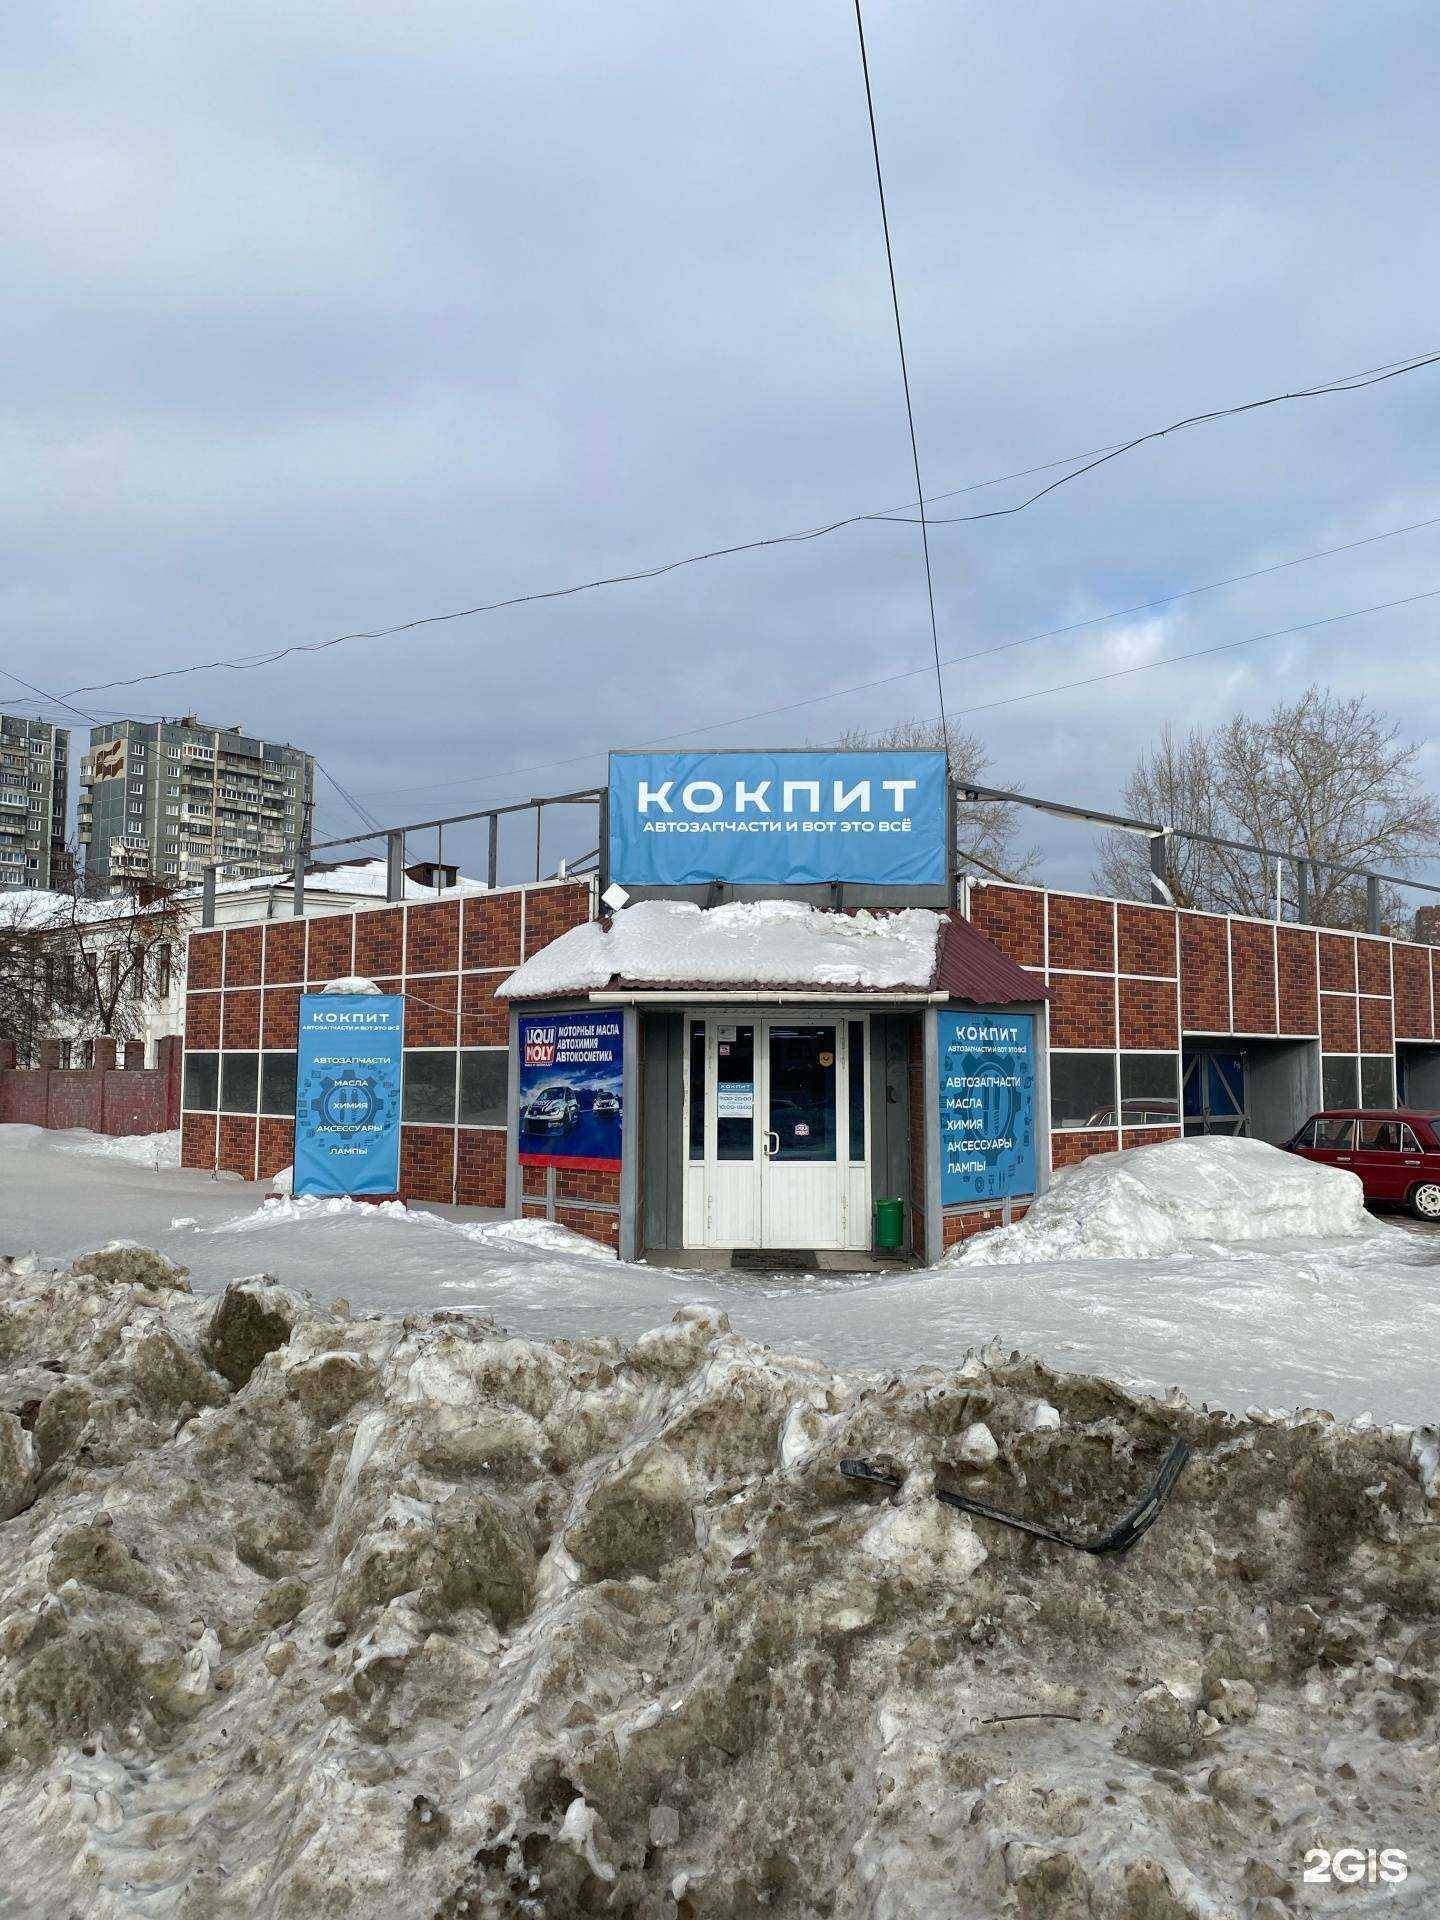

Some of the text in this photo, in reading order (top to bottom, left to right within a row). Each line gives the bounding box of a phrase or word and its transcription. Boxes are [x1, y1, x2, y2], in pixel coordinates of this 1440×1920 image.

[637, 780, 917, 813] КОКПИТ
[643, 818, 912, 833] АВТОЗАПЧАСТИ И ВОТ ЭТО ВСЁ
[313, 1013, 389, 1023] КОКПИТ
[526, 1028, 554, 1044] LIQUI
[558, 1024, 620, 1037] МОТОРНЫЕ МАСЛА
[955, 1026, 1018, 1041] КОКПИТ
[557, 1037, 599, 1050] АВТОХИМИЯ
[947, 1045, 992, 1053] АВТОЗАПЧАСТИ
[526, 1045, 554, 1062] MOLY
[556, 1050, 613, 1063] АВТОКОСМЕТИКА
[946, 1077, 1021, 1088] АВТОЗАПЧАСТИ
[946, 1098, 983, 1109] МАСЛА
[946, 1119, 983, 1130] ХИМИЯ
[947, 1138, 1012, 1152] АКСЕССУАРЫ
[948, 1161, 986, 1174] ЛАМПЫ
